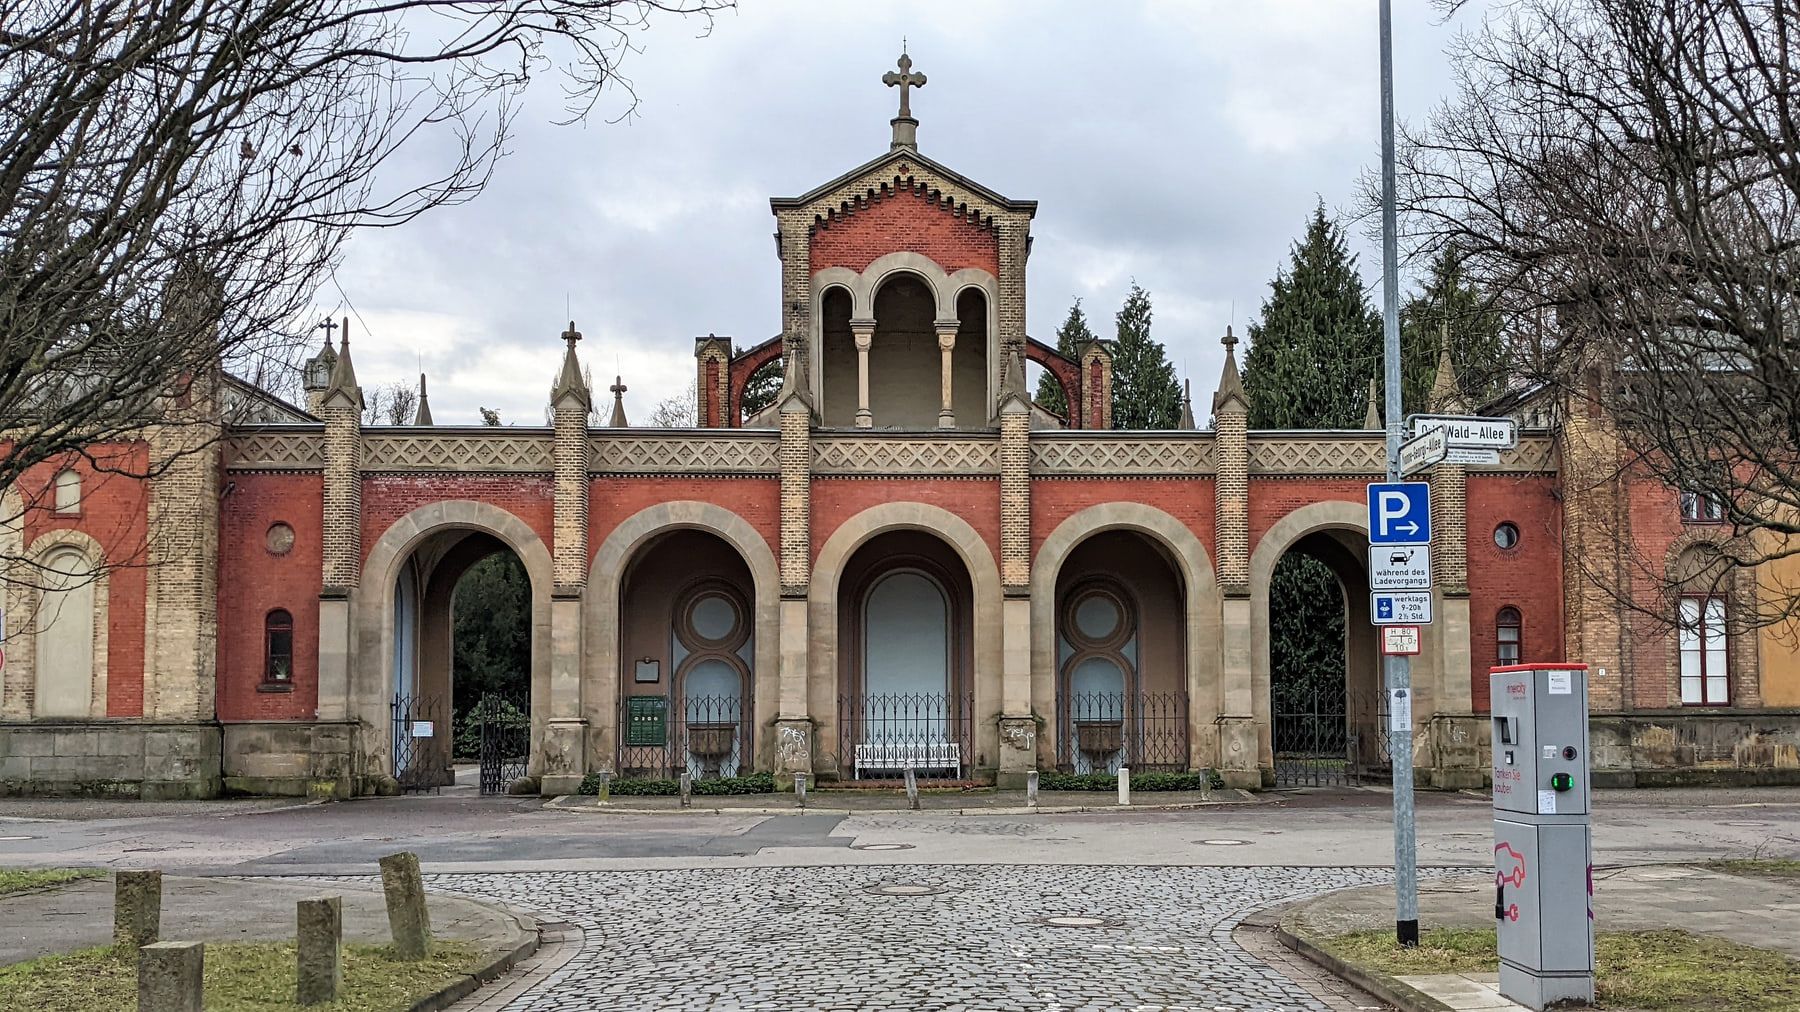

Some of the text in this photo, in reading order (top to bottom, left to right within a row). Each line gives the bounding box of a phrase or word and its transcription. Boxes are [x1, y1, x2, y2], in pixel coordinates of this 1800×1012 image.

[1421, 424, 1504, 440] OWald-Allee
[1379, 491, 1410, 536] P
[1376, 568, 1426, 576] während des
[1374, 577, 1427, 586] Ladevorgangs
[1394, 595, 1428, 604] werktags
